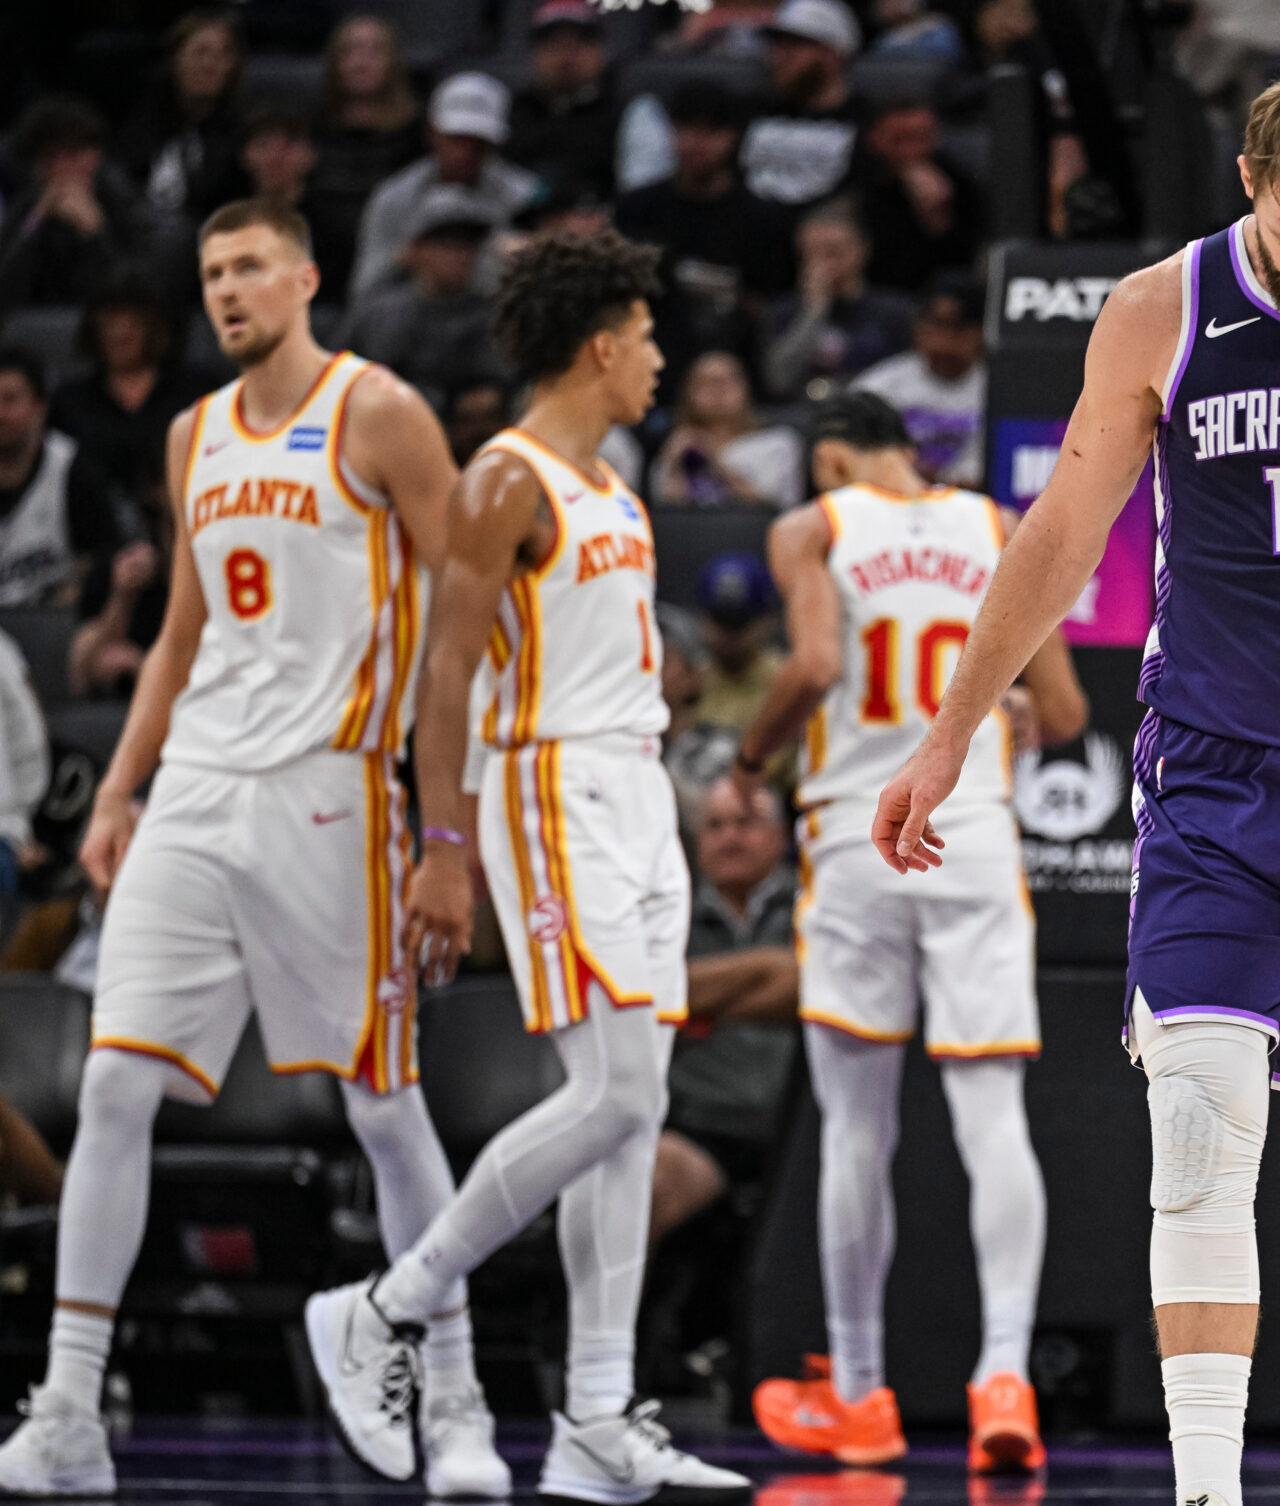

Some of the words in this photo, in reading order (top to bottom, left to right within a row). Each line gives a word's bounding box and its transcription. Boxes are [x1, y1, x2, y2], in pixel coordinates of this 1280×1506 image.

[1005, 277, 1121, 321] PAT
[224, 547, 274, 623] 8
[637, 597, 655, 674] 1
[860, 613, 972, 726] 10
